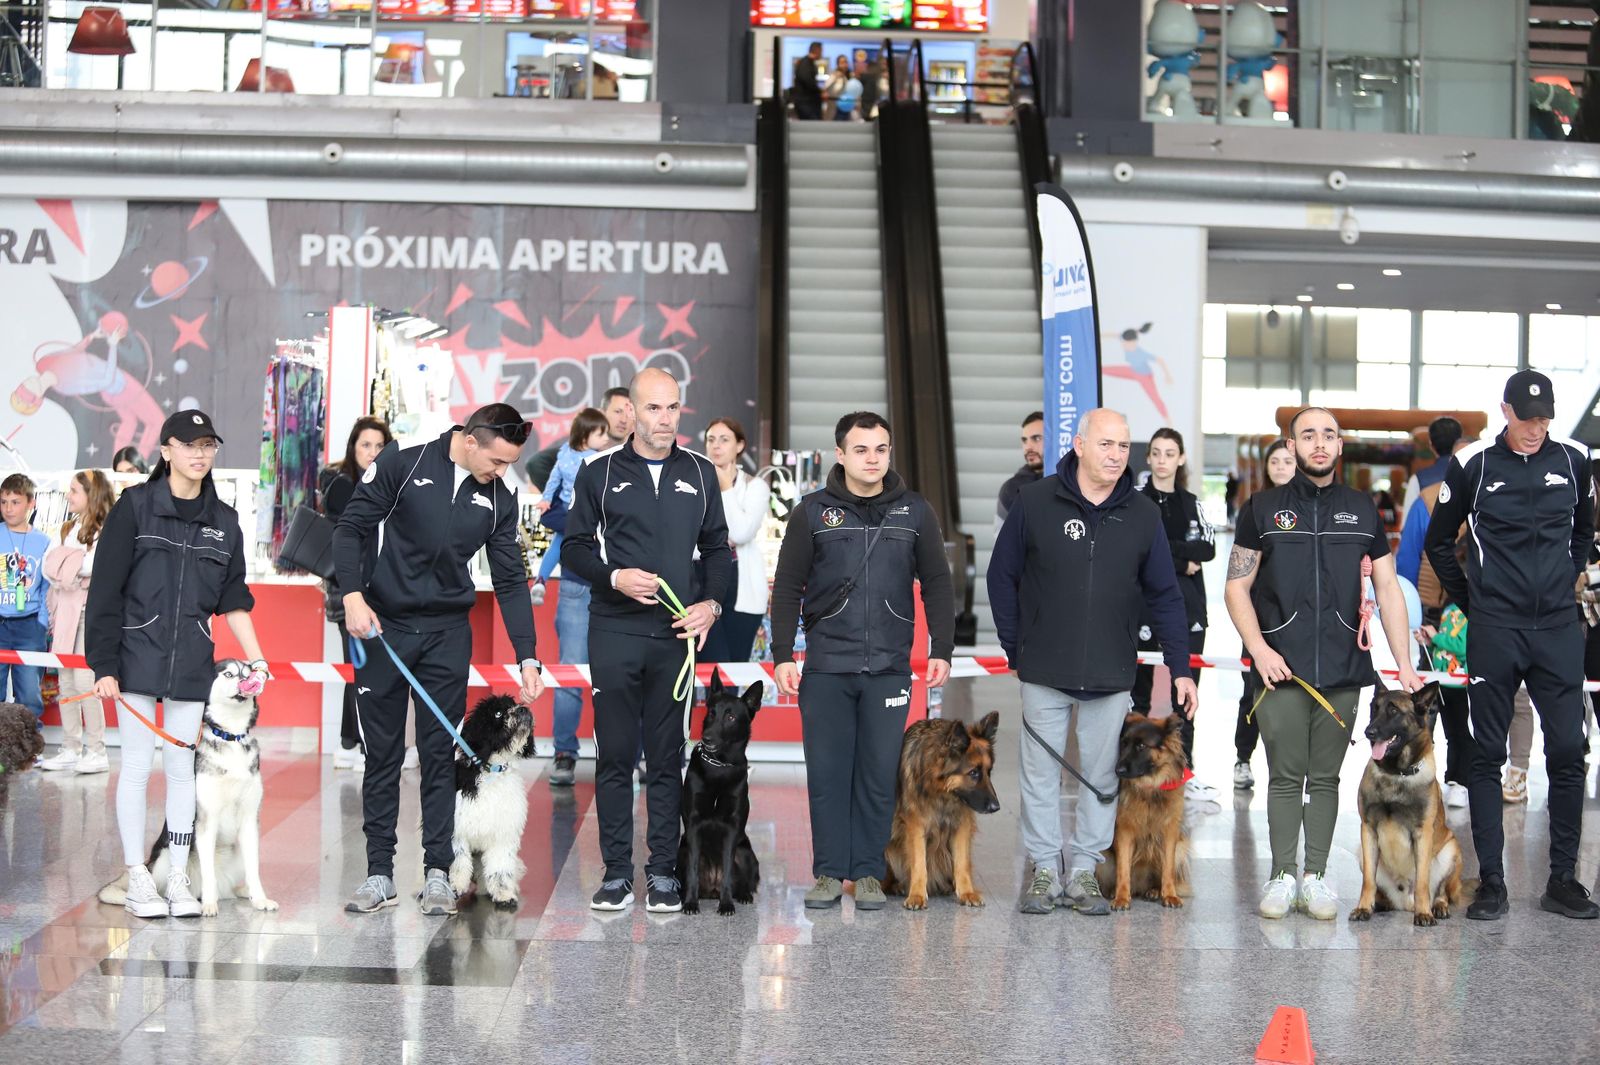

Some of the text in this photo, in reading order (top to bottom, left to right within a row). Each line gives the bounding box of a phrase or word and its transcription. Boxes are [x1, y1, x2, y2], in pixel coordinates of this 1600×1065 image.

[300, 227, 729, 275] PRÓXIMA APERTURA
[885, 695, 908, 709] PUMA
